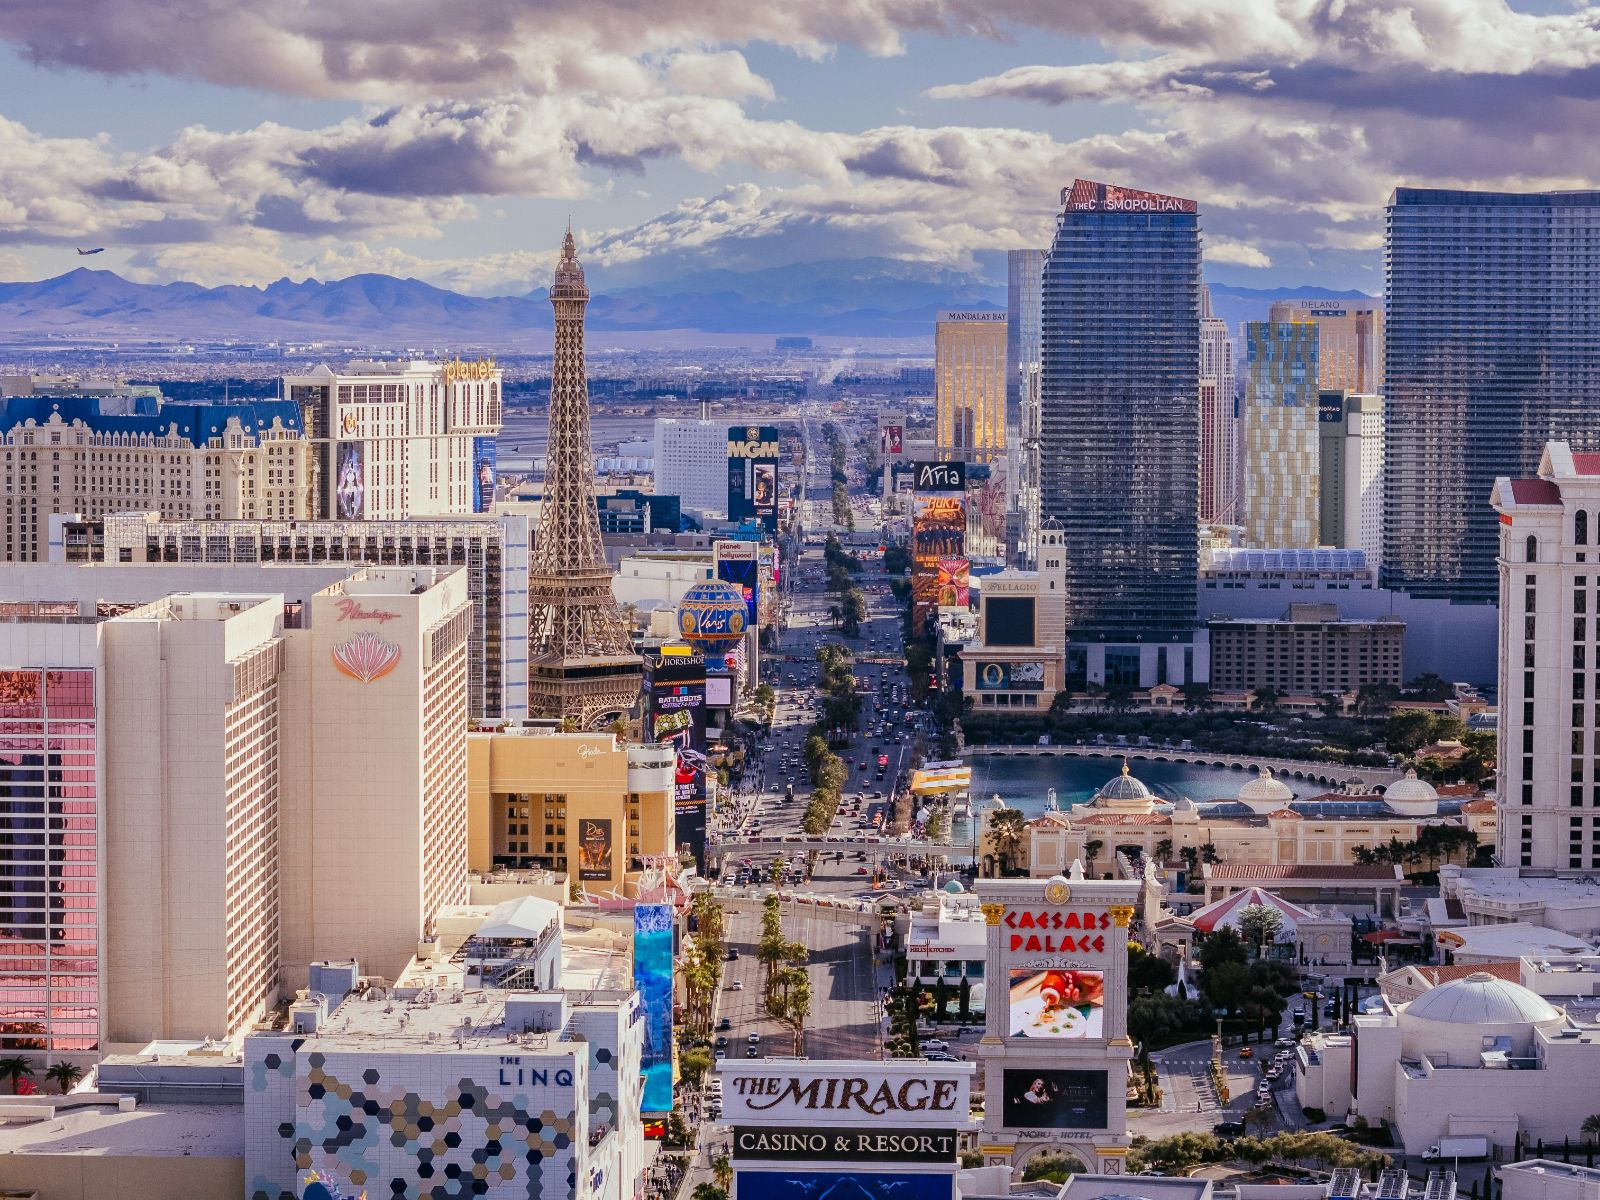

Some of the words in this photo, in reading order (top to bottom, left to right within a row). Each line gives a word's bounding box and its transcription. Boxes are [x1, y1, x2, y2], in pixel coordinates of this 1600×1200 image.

[1088, 199, 1183, 210] CSMOPOLITAN
[1301, 301, 1340, 309] DELANO
[948, 312, 990, 320] MANDALAY
[446, 355, 497, 383] planet
[727, 440, 780, 458] MGM
[919, 465, 959, 486] Aria
[927, 496, 962, 511] BUKIS
[985, 583, 1037, 591] BELLAGIO
[698, 606, 726, 637] Paris
[664, 656, 705, 666] HORSESHOE
[658, 694, 703, 704] BATTLEBOTS
[1004, 911, 1111, 930] CAESARS
[1010, 934, 1105, 953] PALACE
[499, 1056, 521, 1065] THE
[499, 1068, 574, 1087] LINQ
[732, 1077, 782, 1095] THE
[745, 1077, 959, 1115] MIRAGE
[739, 1133, 827, 1151] CASINO
[834, 1135, 850, 1151] &
[857, 1135, 953, 1153] RESORT
[1018, 1130, 1052, 1139] NOBU
[1060, 1131, 1093, 1139] HOTEL
